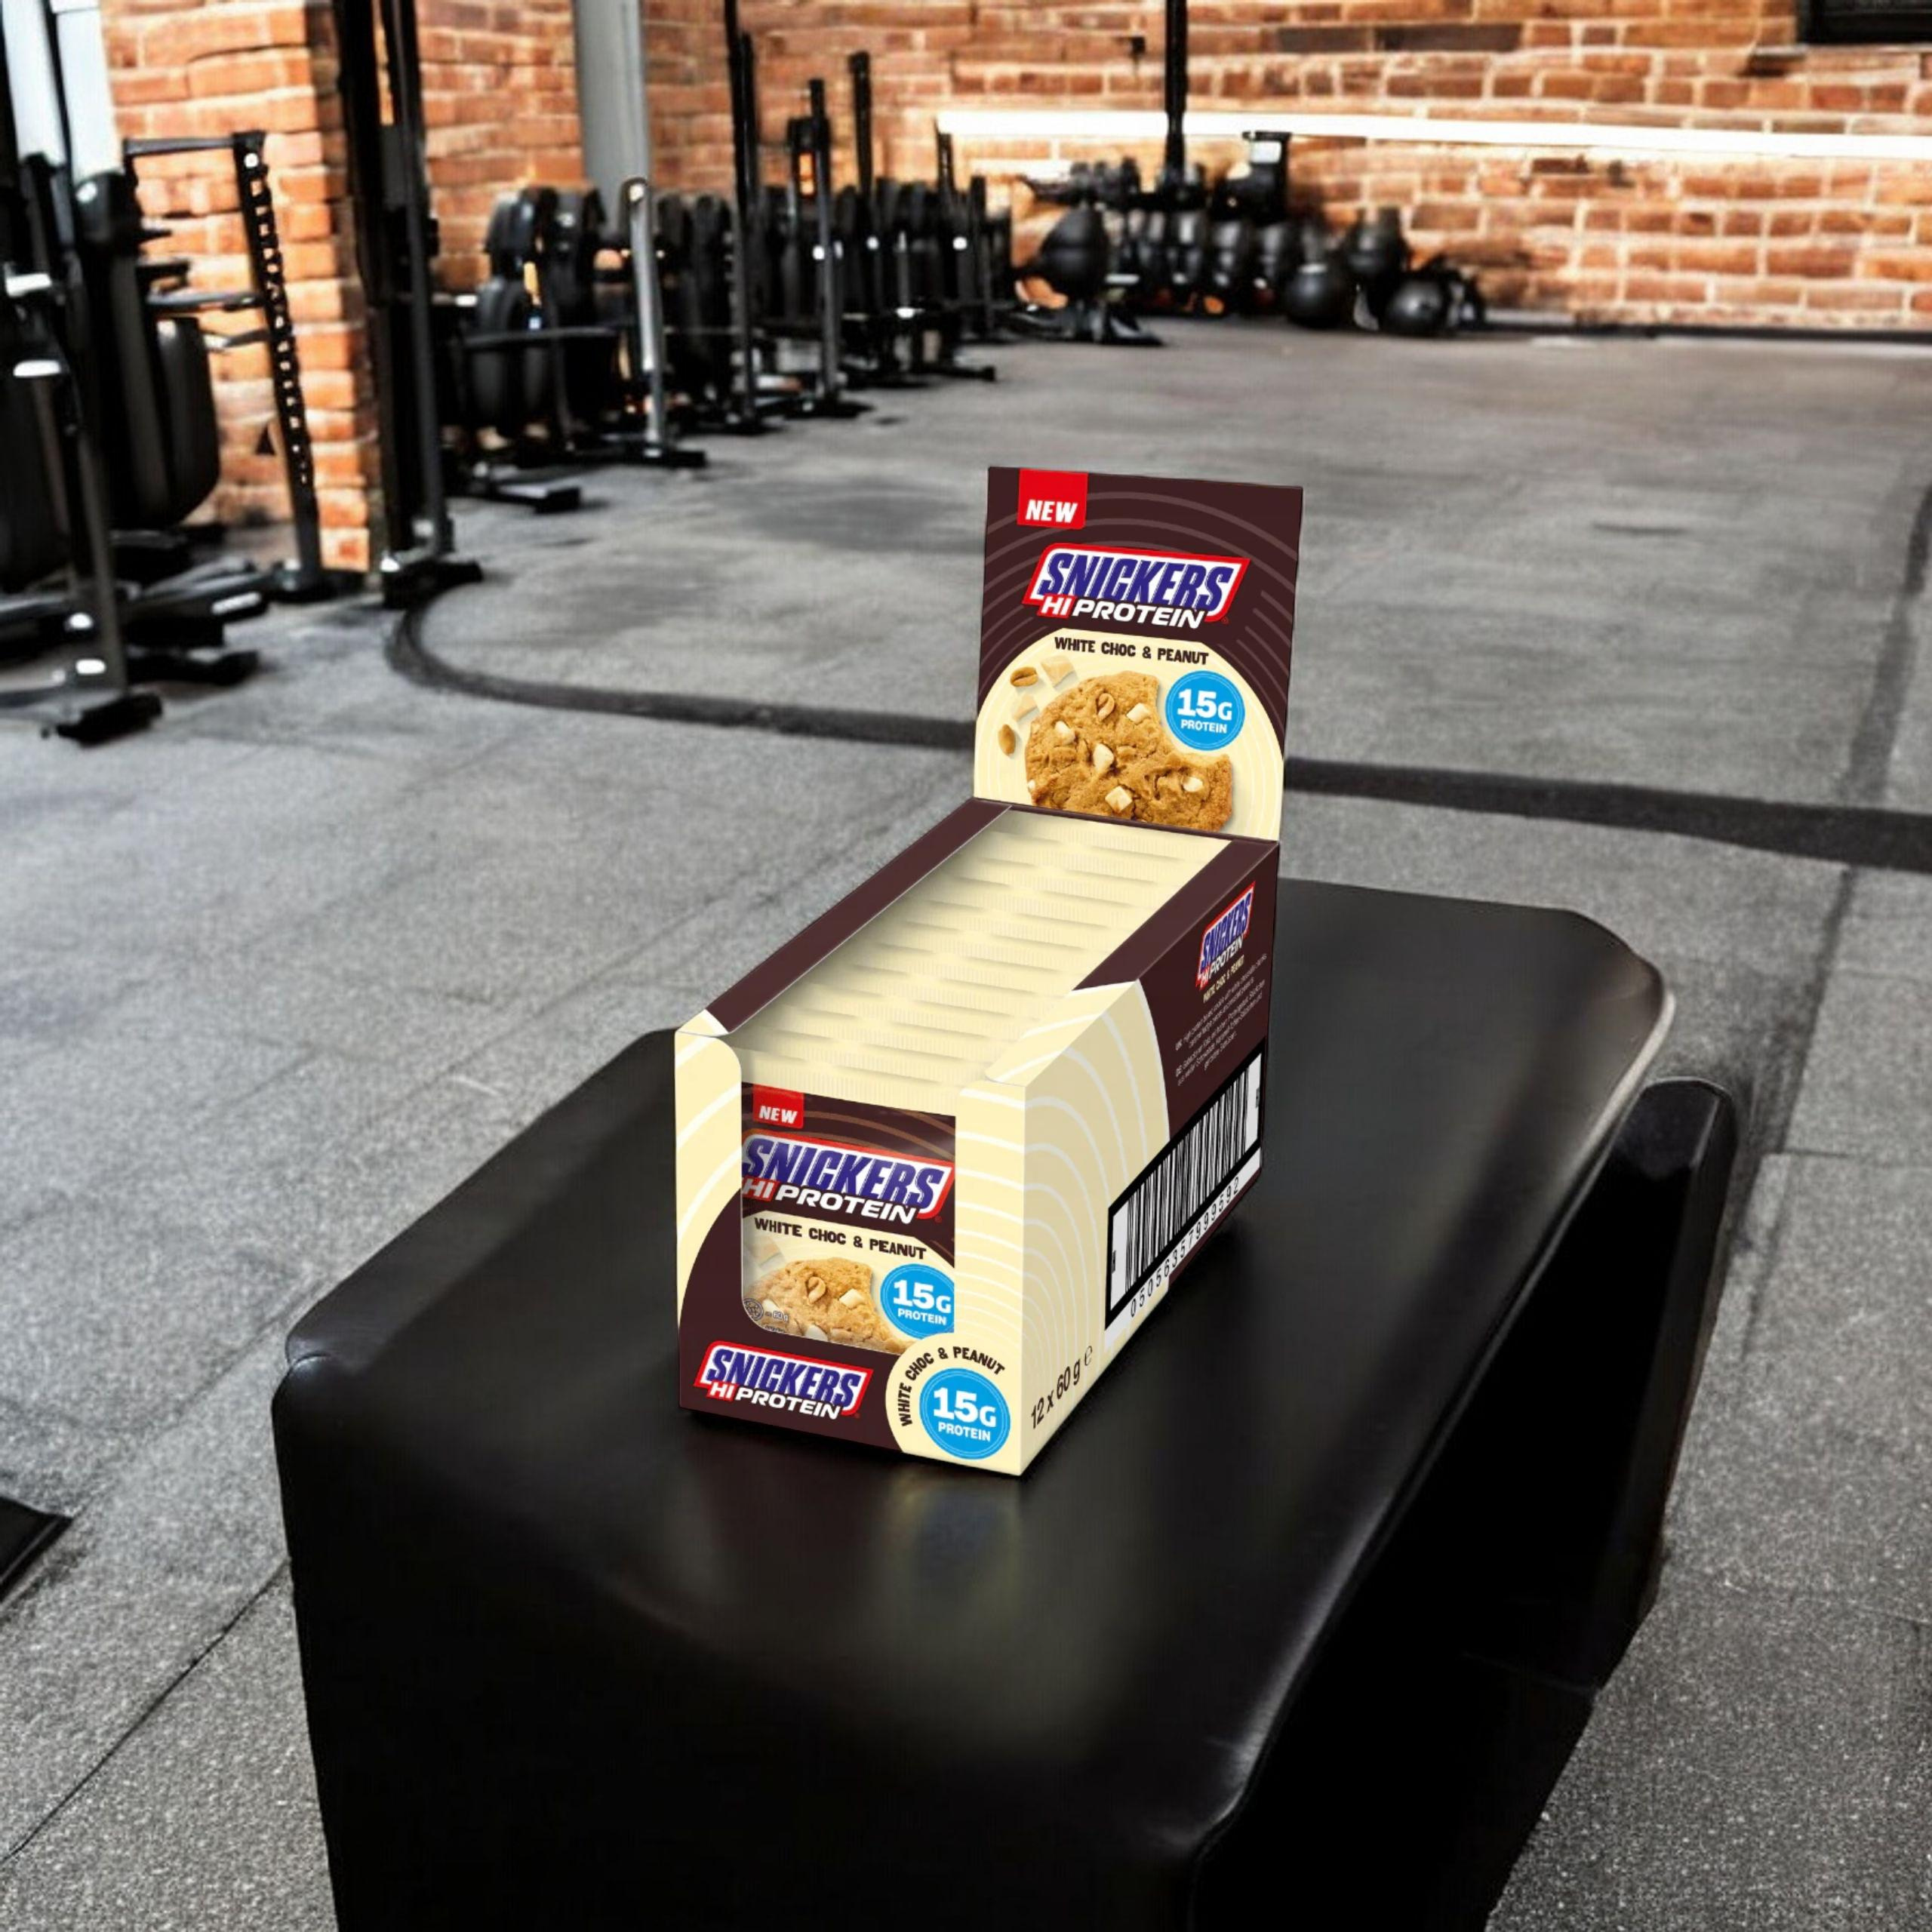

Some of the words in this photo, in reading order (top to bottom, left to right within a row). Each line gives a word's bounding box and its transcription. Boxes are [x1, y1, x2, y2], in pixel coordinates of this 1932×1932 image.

[1025, 499, 1078, 524] NEW
[1036, 552, 1235, 613] SNICKERS
[1041, 595, 1072, 617] HI
[1072, 599, 1205, 629] PROTEIN
[1054, 636, 1095, 654] WHITE
[1101, 641, 1137, 657] CHOC
[1142, 646, 1152, 660] &
[1157, 648, 1209, 666] PEANUT
[1177, 688, 1233, 721] 15G
[1180, 718, 1228, 734] PROTEIN
[1201, 891, 1252, 971] SNICKERS
[758, 1105, 798, 1124] NEW
[742, 1137, 944, 1208] SNICKERS
[742, 1178, 775, 1199] HI
[775, 1186, 918, 1225] PROTEIN
[754, 1217, 802, 1238] WHITE
[808, 1227, 847, 1245] CHOC
[853, 1235, 863, 1249] &
[869, 1238, 927, 1260] PEANUT
[893, 1279, 952, 1314] 15G
[897, 1307, 947, 1326] PROTEIN
[706, 1348, 862, 1408] SNICKERS
[897, 1382, 913, 1427] WHITE
[905, 1352, 935, 1382] CHOC
[937, 1346, 949, 1360] &
[952, 1346, 1006, 1375] PEANUT
[1031, 1396, 1044, 1430] 12
[1046, 1389, 1054, 1414] x
[1057, 1365, 1071, 1401] 60
[1073, 1358, 1081, 1386] g
[709, 1383, 735, 1401] HI
[735, 1387, 841, 1420] PROTEIN
[933, 1387, 998, 1429] 15G
[937, 1421, 992, 1442] PROTEIN
